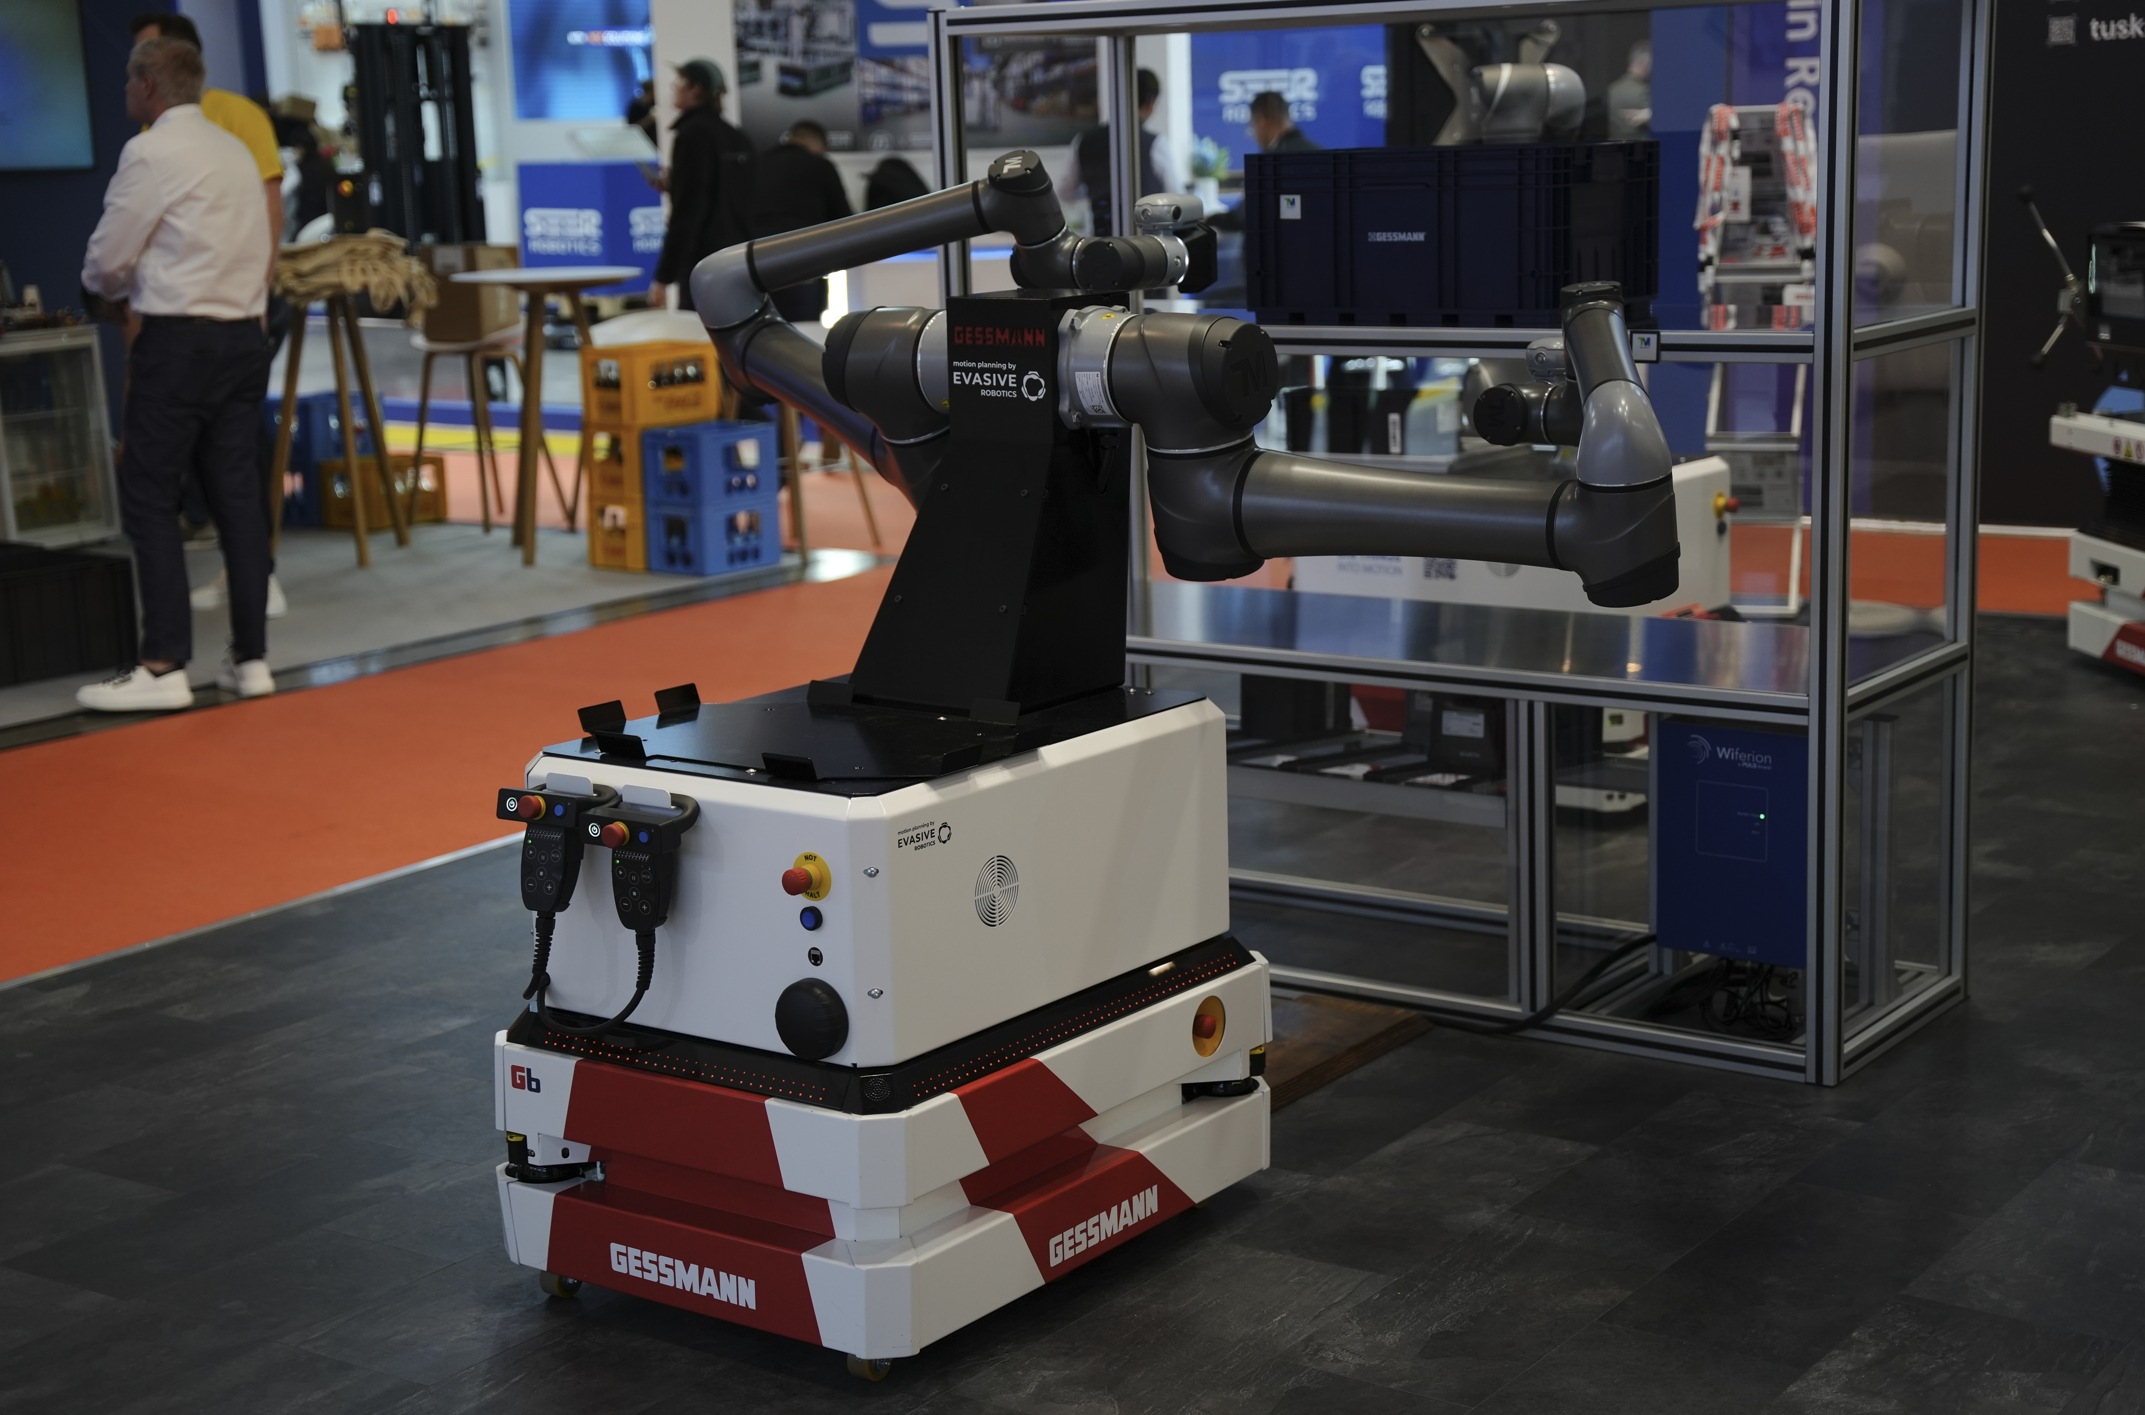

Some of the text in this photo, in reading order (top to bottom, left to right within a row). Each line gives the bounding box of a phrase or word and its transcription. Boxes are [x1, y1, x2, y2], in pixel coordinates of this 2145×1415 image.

[1376, 231, 1426, 242] GESSMANN
[953, 326, 1046, 347] GESSMANN
[953, 360, 1017, 370] motion planning by
[953, 371, 1018, 387] EVASIVE
[980, 389, 1018, 398] ROBOTICS
[1716, 745, 1772, 764] Wiferion
[897, 828, 935, 848] EVASIVE
[914, 840, 936, 851] ROBOTICS
[804, 891, 820, 899] HALT
[511, 1064, 541, 1093] Gb
[1049, 1184, 1158, 1268] GESSMANN
[610, 1242, 756, 1310] GESSMANN
